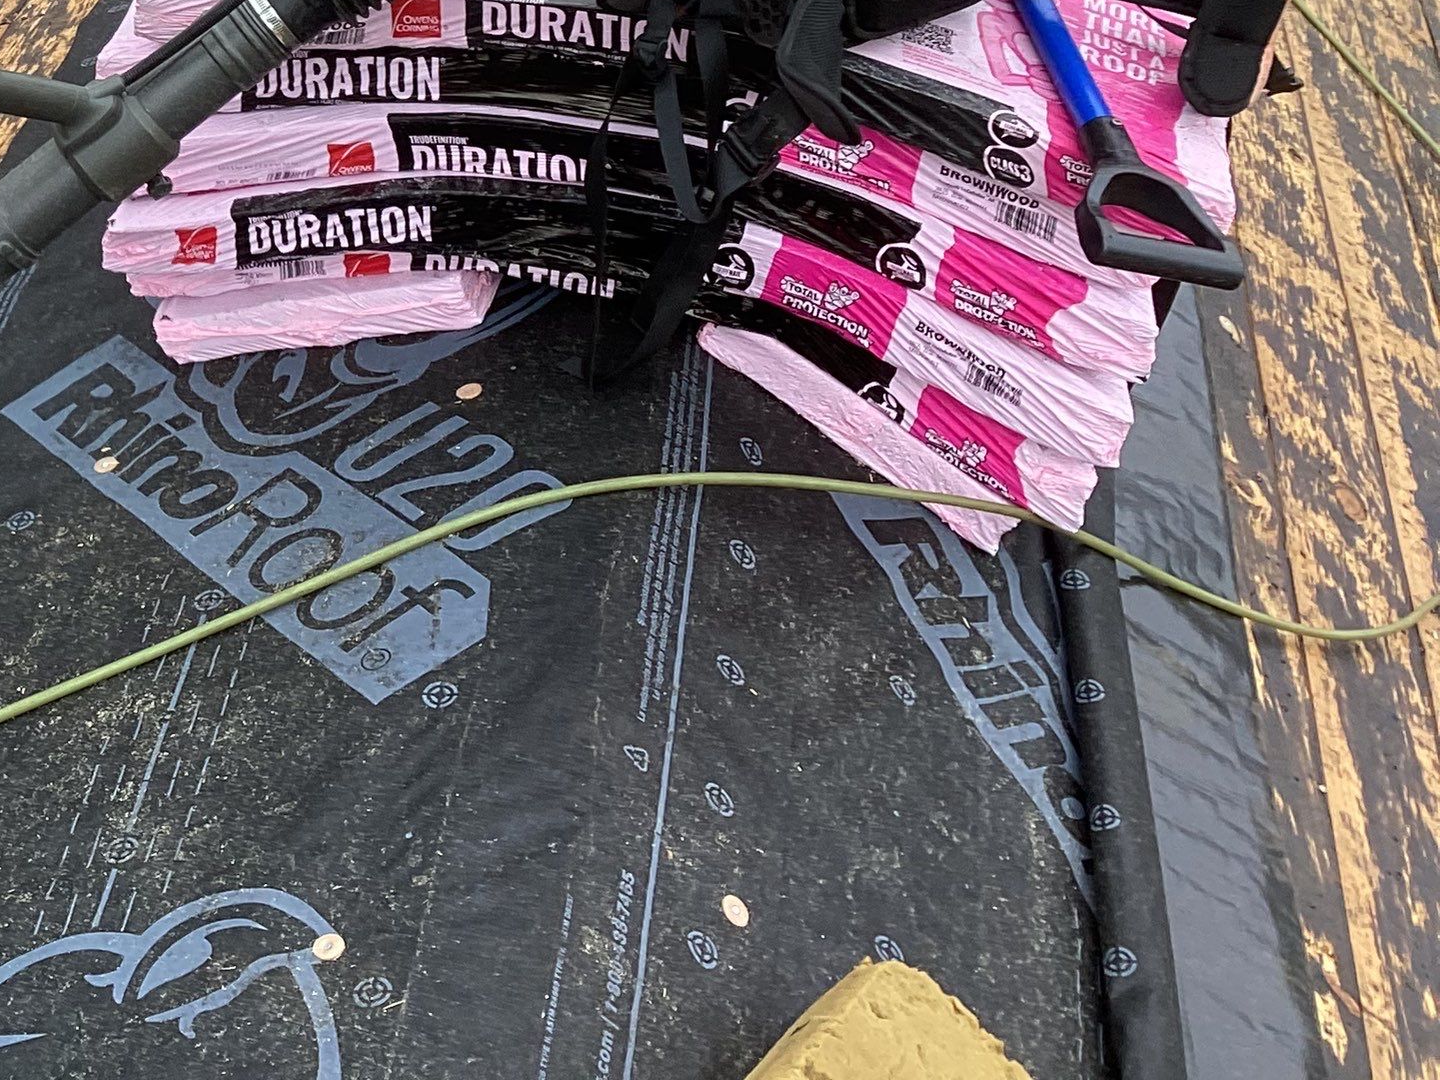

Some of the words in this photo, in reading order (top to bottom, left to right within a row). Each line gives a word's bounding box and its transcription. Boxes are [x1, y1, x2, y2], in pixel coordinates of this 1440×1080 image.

[396, 23, 440, 32] CORNING
[403, 15, 439, 24] OWENS
[1083, 10, 1166, 57] THAN
[1078, 45, 1165, 86] ROOF
[1082, 30, 1140, 61] JUST
[1149, 55, 1165, 70] A
[256, 56, 441, 102] DURATION
[409, 136, 469, 145] TRUDEFINITION
[940, 165, 1040, 209] BROWNWOOD
[248, 205, 433, 255] DURATION
[789, 281, 820, 302] TOTAL
[783, 295, 868, 338] PROTECTION
[334, 401, 573, 552] U20
